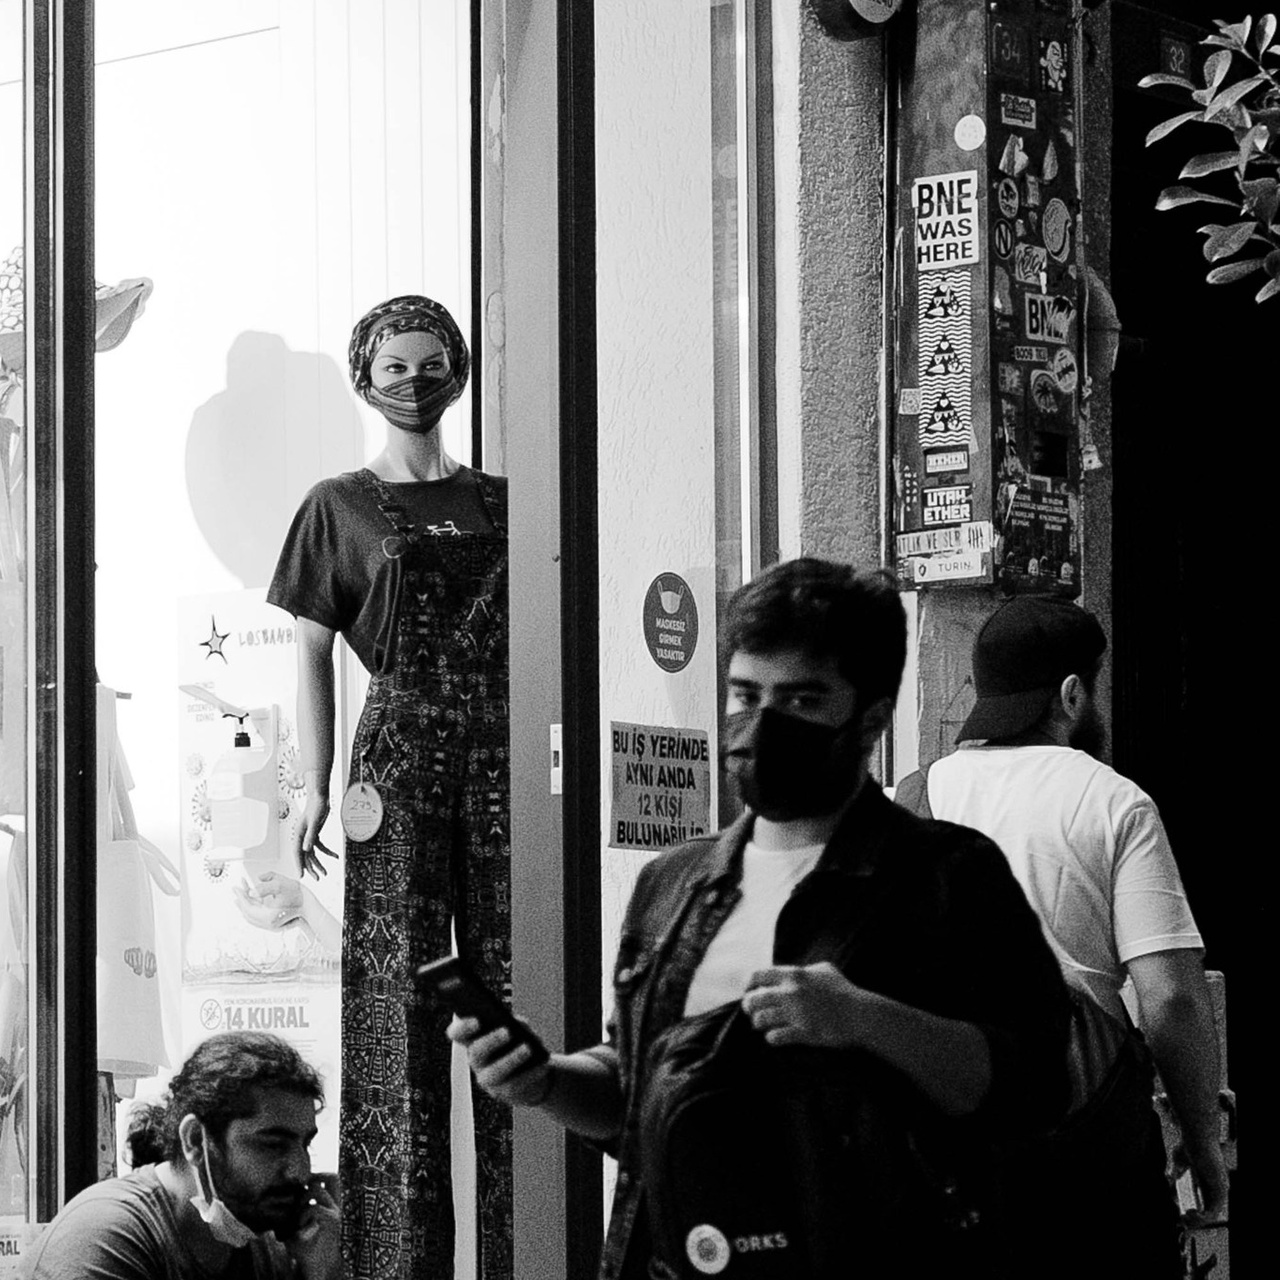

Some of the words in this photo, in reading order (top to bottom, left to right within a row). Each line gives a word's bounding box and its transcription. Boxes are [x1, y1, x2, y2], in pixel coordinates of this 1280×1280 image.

[917, 178, 973, 220] BNE
[917, 218, 974, 242] WAS
[917, 240, 974, 265] HERE
[927, 489, 966, 507] UTAH
[923, 504, 971, 522] ETHER
[938, 561, 972, 573] TURIN
[613, 730, 628, 754] BU
[632, 727, 646, 762] İŞ
[650, 730, 709, 762] YERİNDE
[625, 762, 654, 787] AYNI
[657, 764, 696, 790] ANDA
[637, 793, 651, 816] 12
[654, 789, 683, 824] KİŞİ
[224, 1006, 244, 1030] 14
[248, 1006, 310, 1029] KURAL
